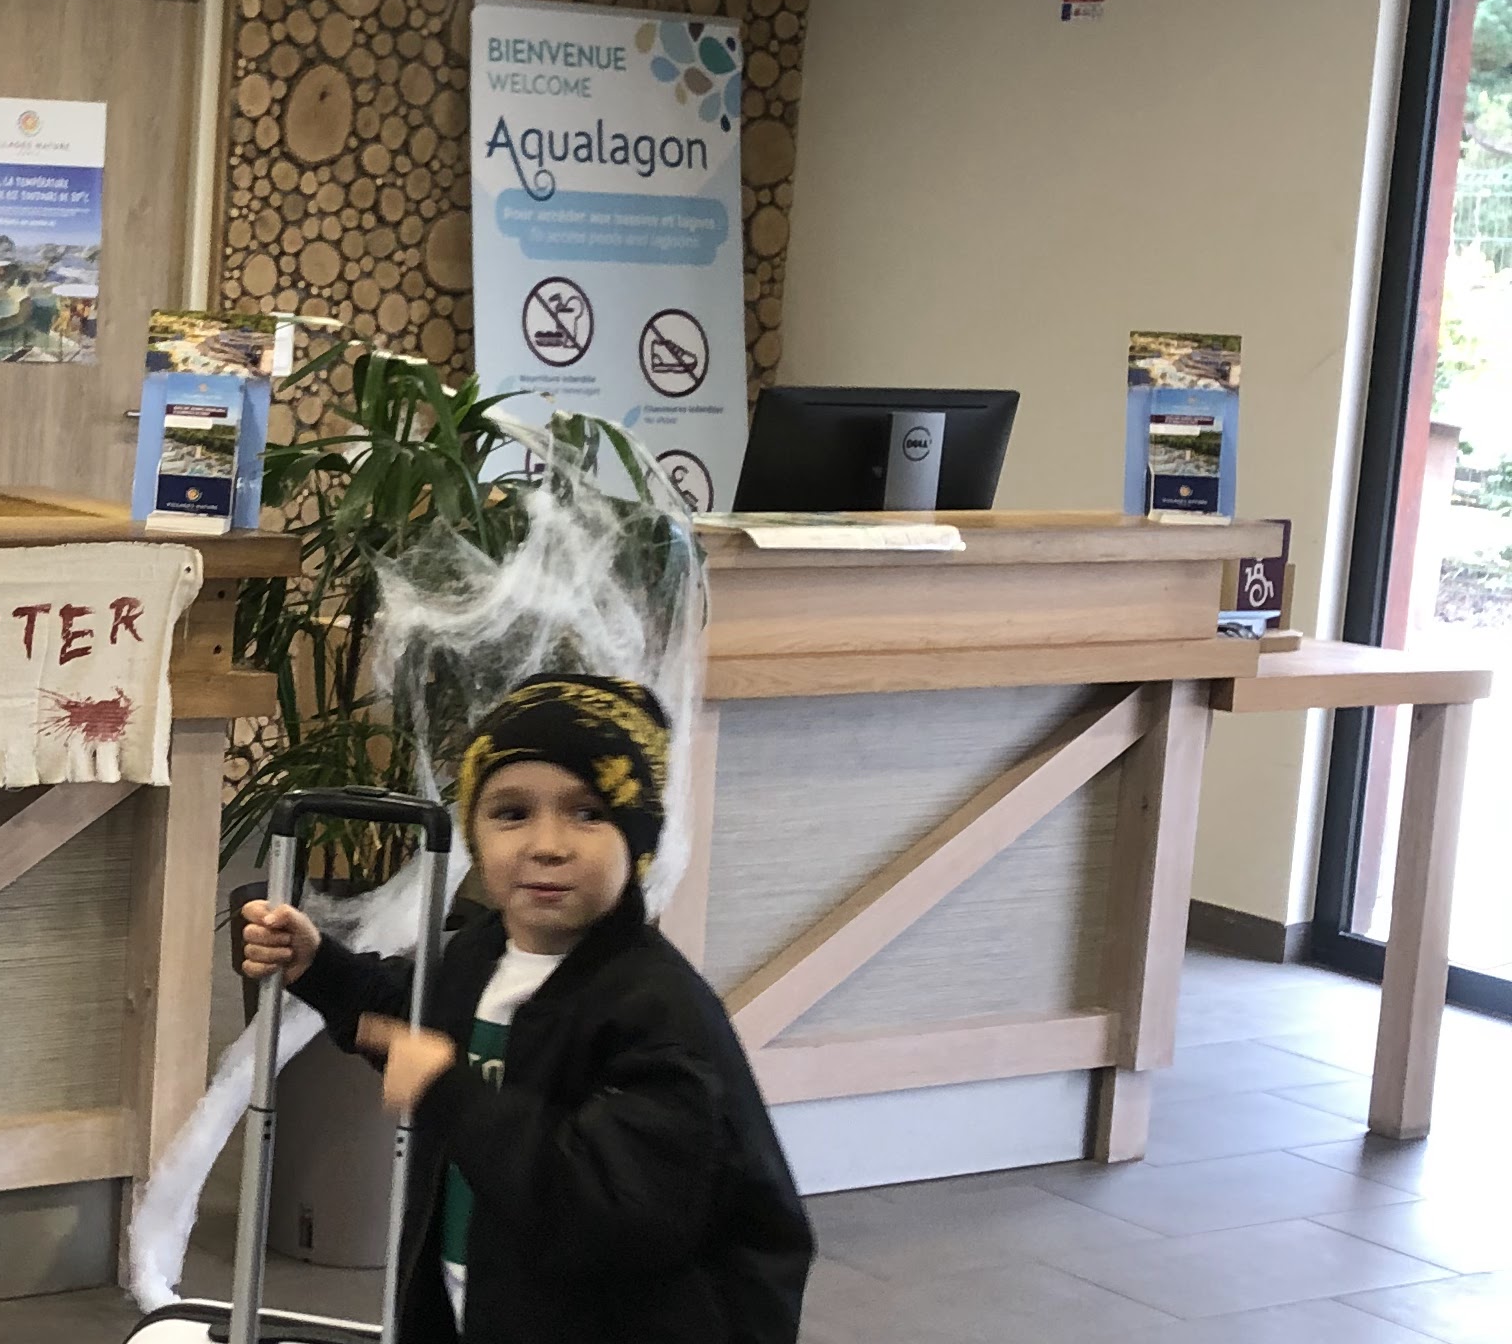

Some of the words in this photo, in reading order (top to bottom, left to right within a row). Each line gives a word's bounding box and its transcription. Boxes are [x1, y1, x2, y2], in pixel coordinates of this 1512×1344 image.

[488, 37, 627, 72] BIENVENUE
[487, 72, 592, 98] WELCOME
[485, 115, 708, 202] Aqualagon
[906, 438, 928, 449] DELL
